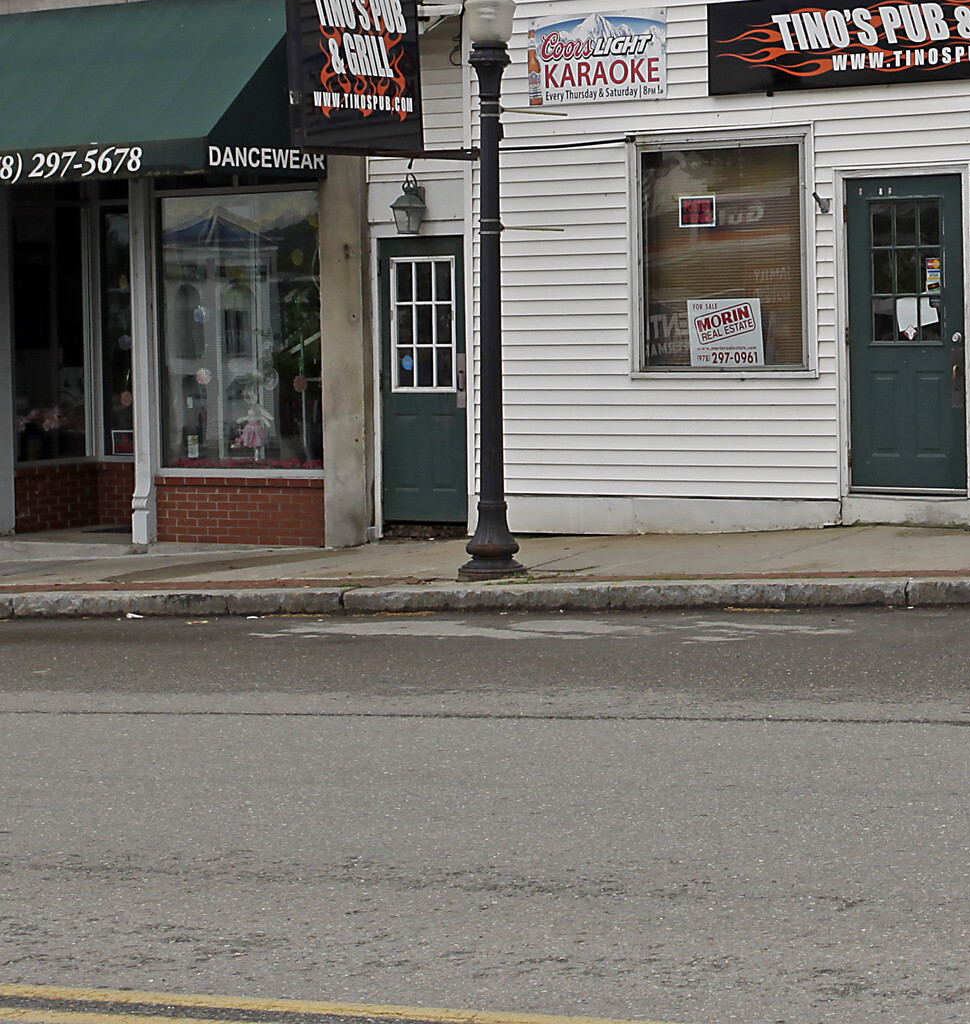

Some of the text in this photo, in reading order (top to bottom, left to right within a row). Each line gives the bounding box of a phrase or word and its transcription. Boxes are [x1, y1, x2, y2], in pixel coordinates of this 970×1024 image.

[771, 7, 873, 52] TINO'S
[878, 2, 950, 47] PUB
[328, 32, 394, 78] & GRILL
[541, 31, 653, 62] Coors LIGHT
[544, 57, 660, 89] KARAOKE
[312, 91, 414, 112] WWW.TINOSPUB.COM
[545, 91, 564, 102] Every
[565, 89, 597, 101] Thursday
[598, 88, 604, 97] &
[605, 87, 638, 99] Saturday
[0, 146, 144, 185] 8) 297-5678
[208, 145, 326, 170] DANCEWEAR
[696, 305, 750, 332] MORIN
[701, 318, 754, 342] REAL ESTATE
[712, 351, 759, 364] 297-0961
